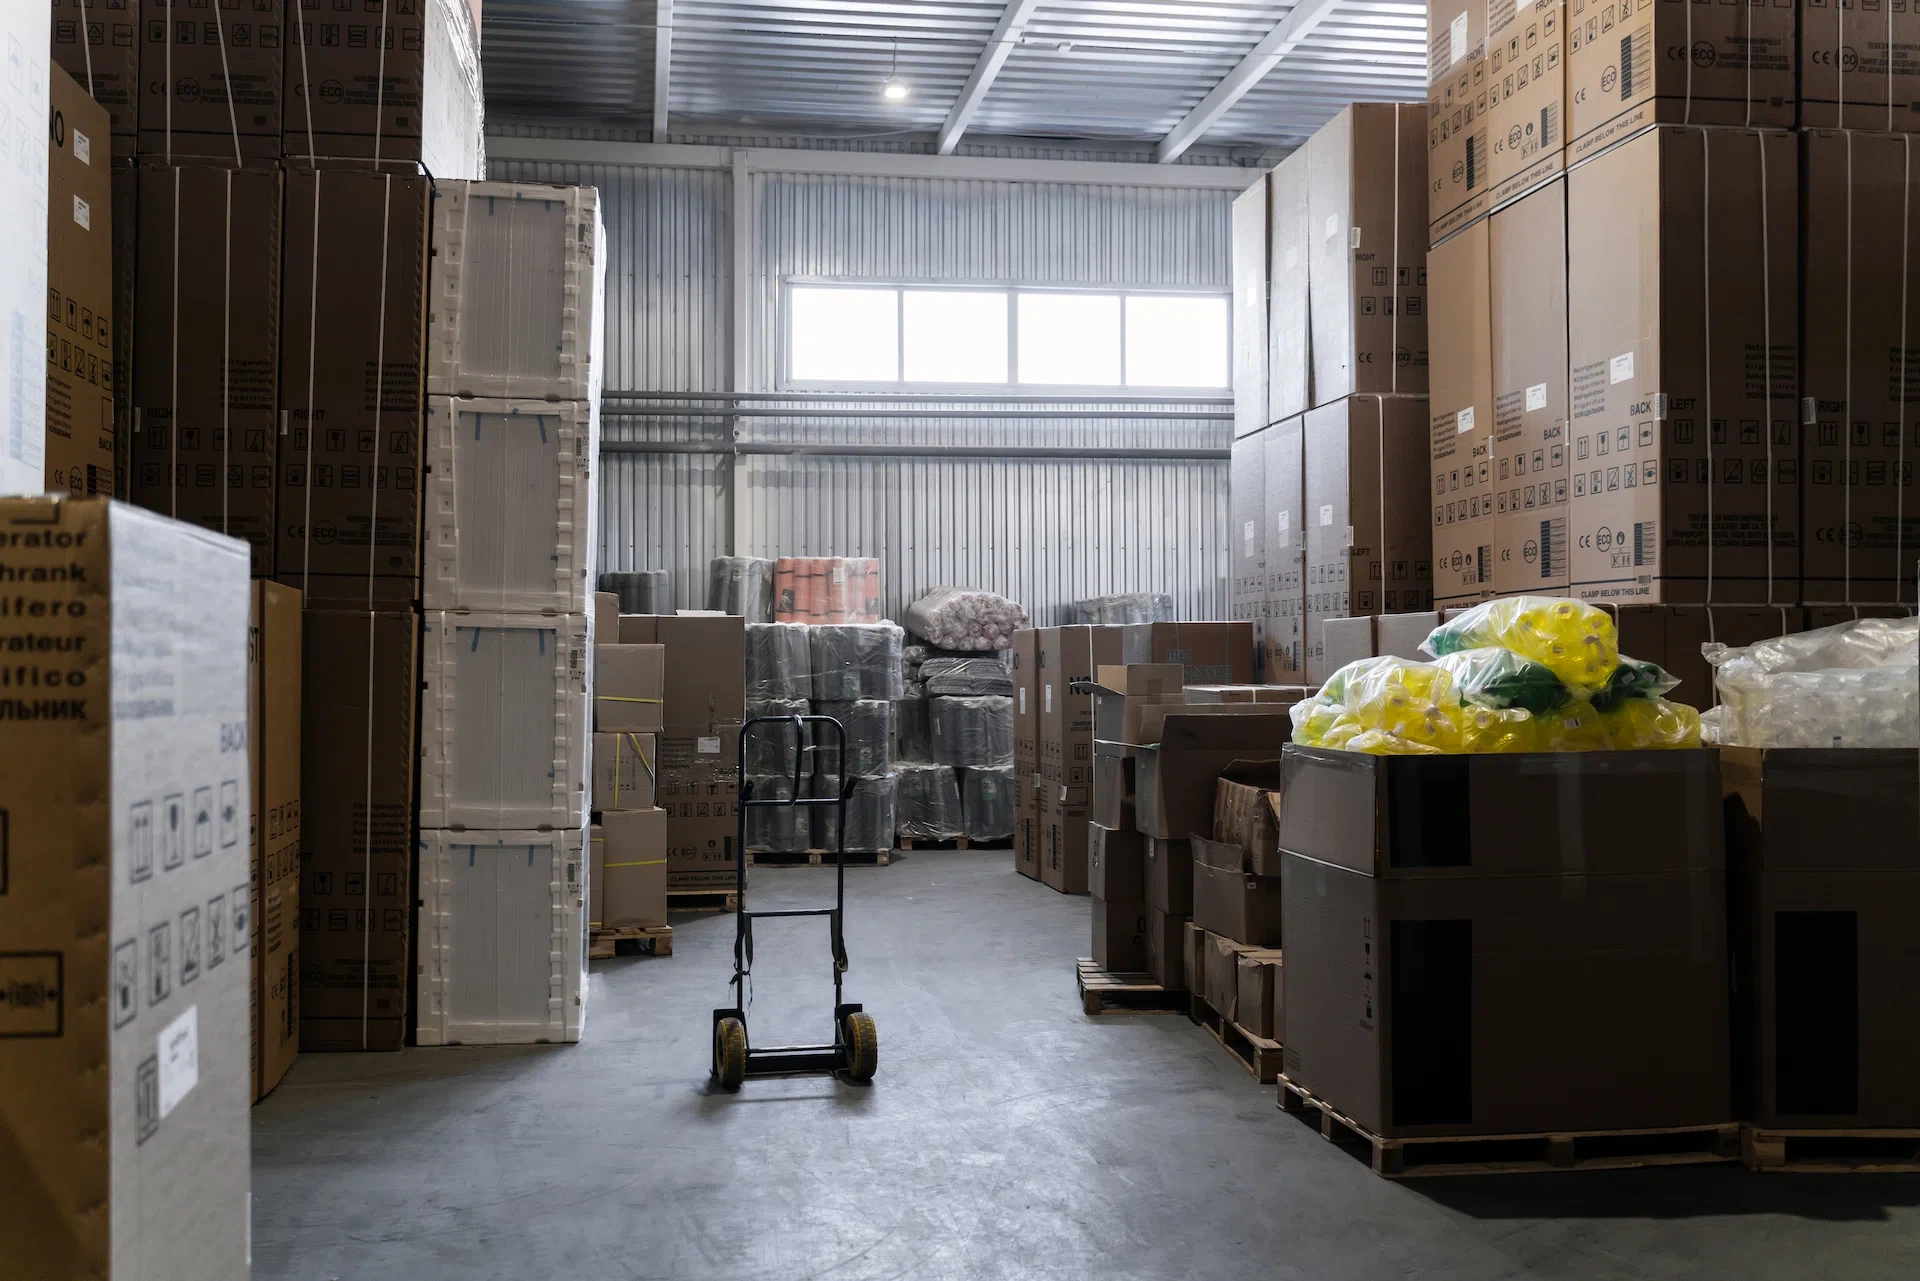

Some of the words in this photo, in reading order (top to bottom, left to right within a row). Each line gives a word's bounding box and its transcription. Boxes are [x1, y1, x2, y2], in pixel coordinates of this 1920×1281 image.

[1693, 49, 1714, 60] ECO
[1812, 50, 1829, 64] CE
[1601, 70, 1616, 88] ECO
[176, 84, 199, 96] ECO
[321, 88, 342, 98] ECO
[1574, 87, 1586, 104] CE
[1508, 130, 1521, 145] ECO
[1575, 138, 1594, 153] CLAMP
[1594, 127, 1615, 143] BELOW
[1616, 117, 1629, 131] THIS
[1629, 111, 1645, 124] LINE
[1452, 165, 1463, 179] ECO
[1495, 185, 1512, 200] CLAMP
[1511, 175, 1531, 192] BELOW
[1530, 168, 1542, 182] THIS
[1541, 162, 1554, 176] LINE
[1356, 253, 1376, 261] RIGHT
[1358, 352, 1372, 363] CE
[1629, 401, 1652, 417] BACK
[1670, 398, 1696, 411] LEFT
[1819, 400, 1848, 413] RIGH
[147, 407, 180, 419] RIGH
[1543, 426, 1561, 441] BACK
[98, 436, 113, 452] BACK
[315, 528, 336, 538] ECO
[1816, 528, 1834, 542] CE
[1579, 534, 1590, 548] CE
[1598, 534, 1610, 545] ECO
[1352, 548, 1371, 556] LEFT
[1502, 549, 1510, 561] CE
[1524, 546, 1536, 557] ECO
[1439, 558, 1448, 569] CE
[1581, 590, 1600, 598] CLAMP
[1600, 588, 1620, 597] BELOW
[1621, 587, 1635, 596] THIS
[1635, 586, 1650, 595] LINE
[220, 721, 247, 754] BAC
[1067, 810, 1086, 818] RIGHT
[681, 848, 696, 856] ECO
